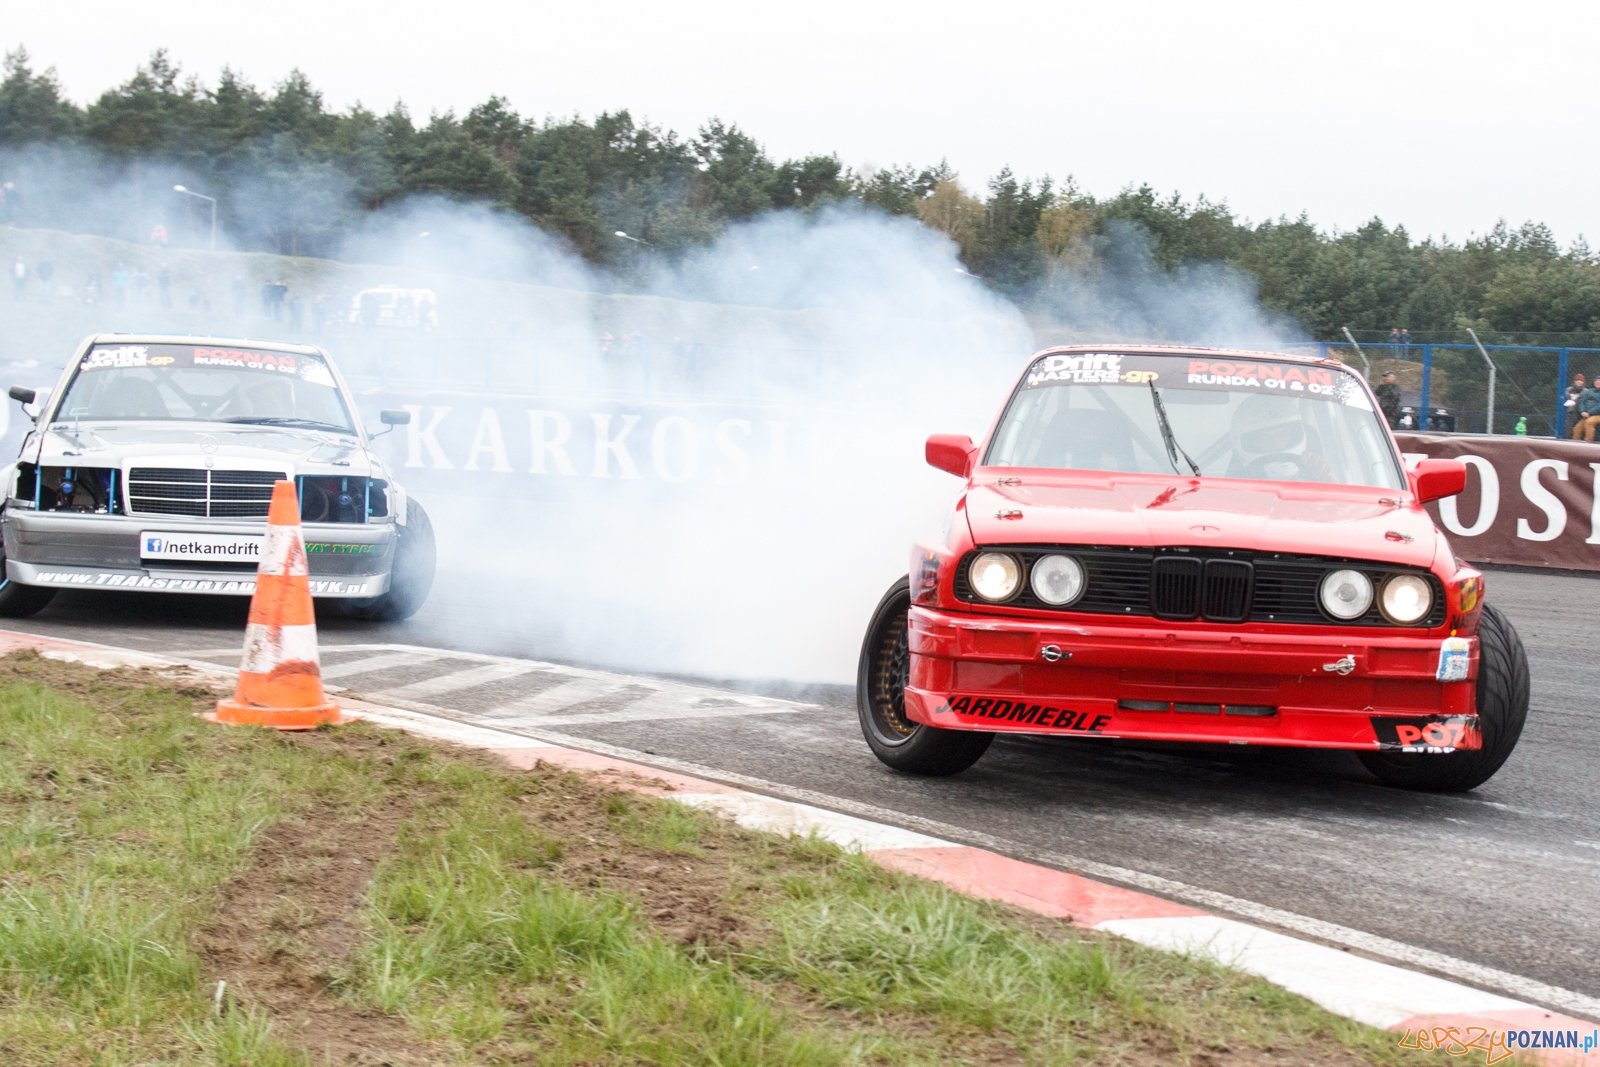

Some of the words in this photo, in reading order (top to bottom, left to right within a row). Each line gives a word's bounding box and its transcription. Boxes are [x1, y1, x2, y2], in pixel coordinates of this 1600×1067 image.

[91, 346, 149, 360] Drift
[194, 348, 296, 367] POZNAŃ
[1044, 353, 1124, 372] Drift
[194, 357, 245, 367] RUNDA
[248, 361, 263, 369] 01
[265, 363, 275, 371] &
[278, 365, 297, 374] 02
[1188, 361, 1333, 386] POZNAŃ
[1188, 373, 1260, 387] RUNDA
[1264, 378, 1286, 389] 01
[1290, 381, 1304, 391] &
[1308, 383, 1334, 396] 02
[1402, 453, 1600, 545] OSI
[332, 543, 376, 554] TYRES
[935, 695, 1112, 735] JARDMEBLE
